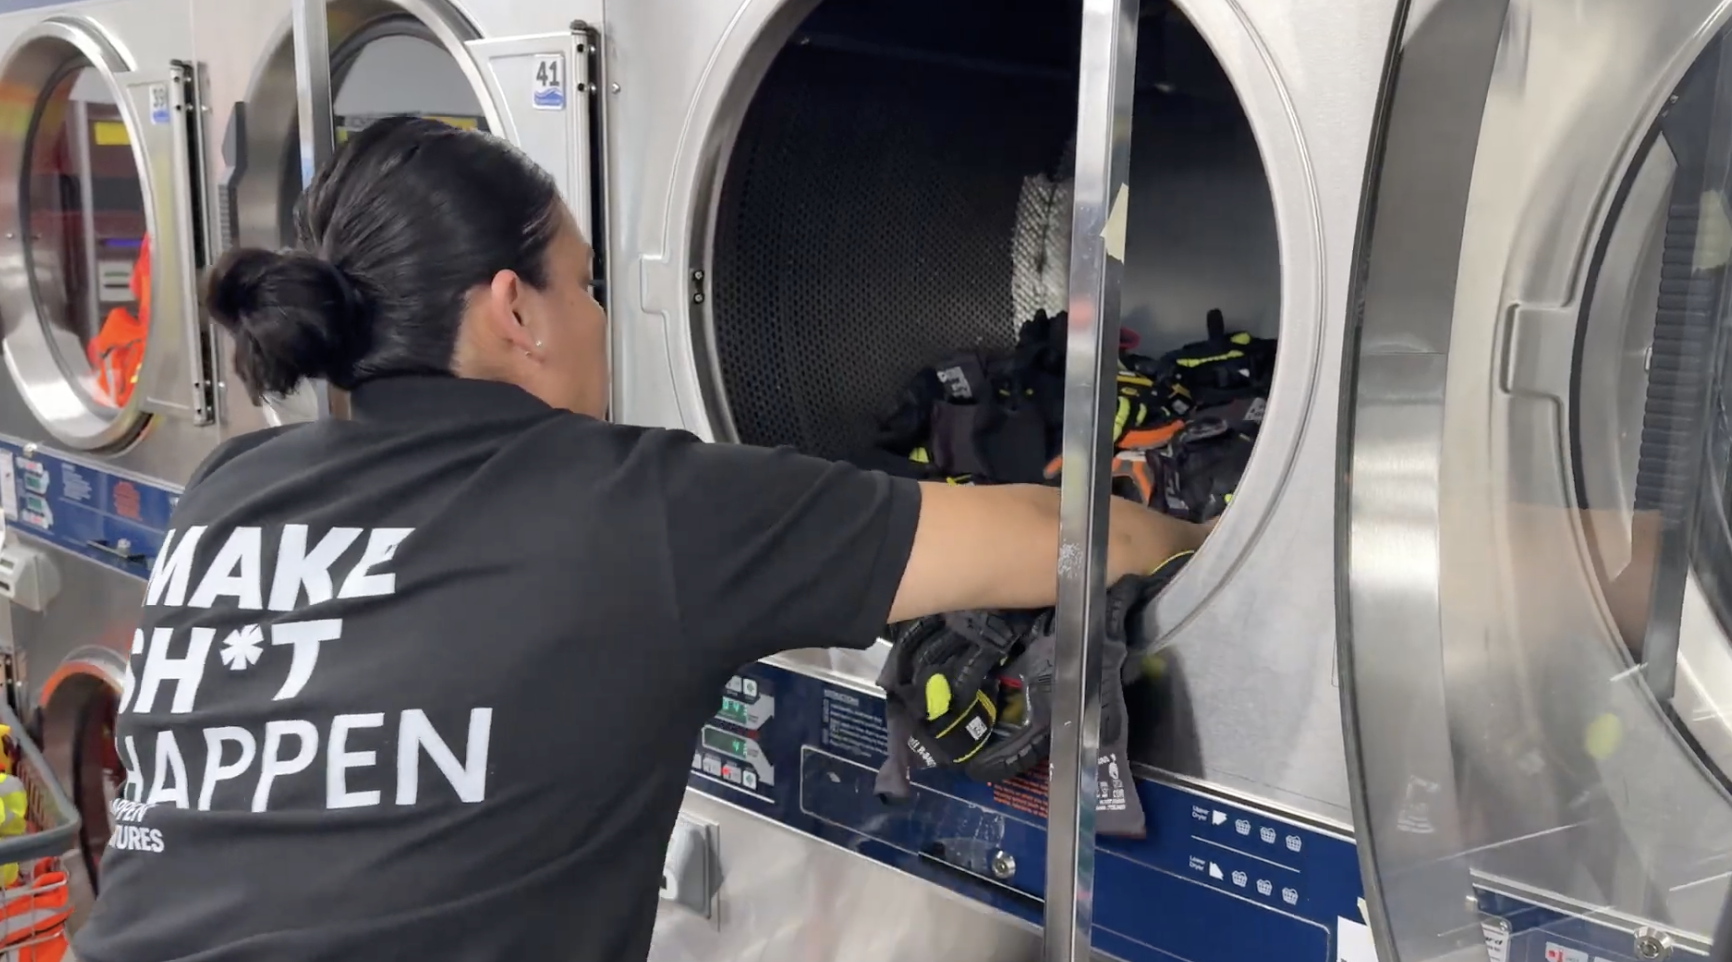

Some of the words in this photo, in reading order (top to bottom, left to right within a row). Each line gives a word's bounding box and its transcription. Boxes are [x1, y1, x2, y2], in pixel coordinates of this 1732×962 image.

[536, 60, 560, 87] 41
[141, 523, 416, 612] MAKE
[114, 706, 494, 813] HAPPEN
